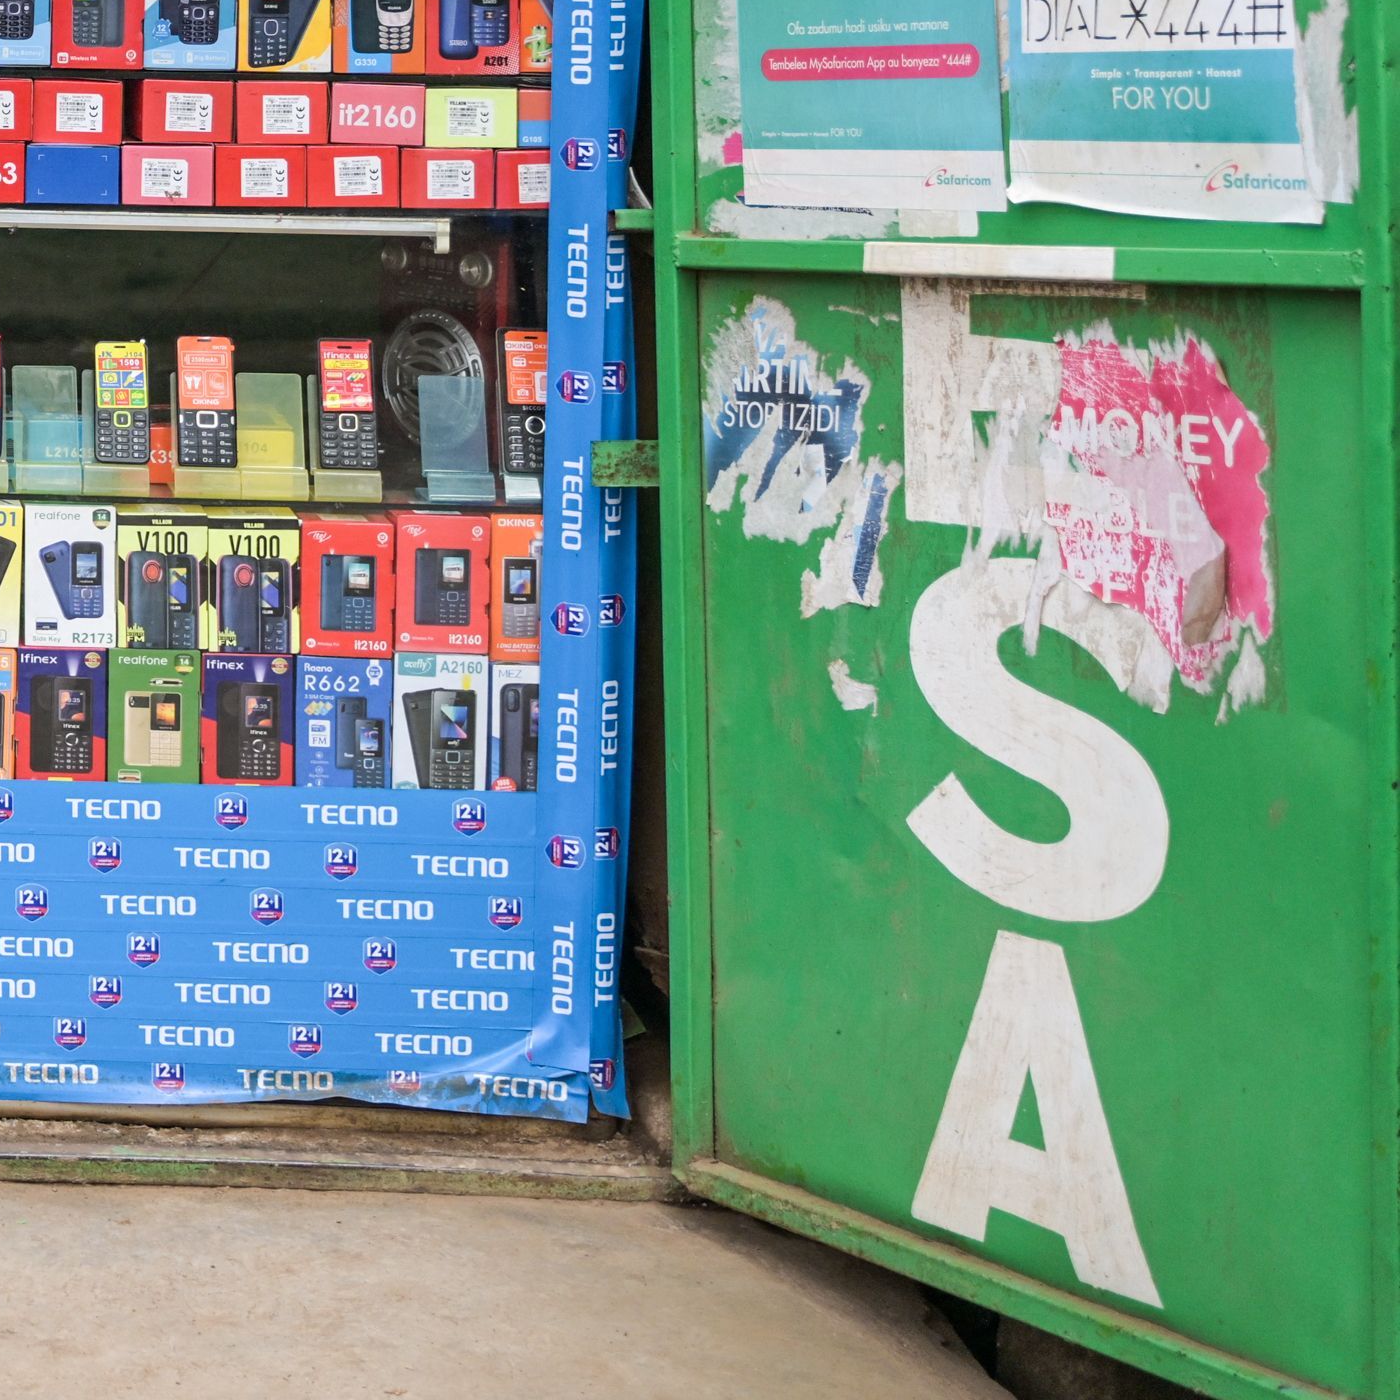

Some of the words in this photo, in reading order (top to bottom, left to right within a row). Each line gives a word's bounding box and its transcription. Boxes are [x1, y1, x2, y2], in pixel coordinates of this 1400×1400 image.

[769, 58, 807, 71] Tembelea
[809, 57, 865, 73] MySafaricom
[867, 57, 886, 72] App
[1090, 68, 1122, 80] Simple
[1134, 68, 1192, 80] Transparent
[1206, 67, 1241, 78] Honest
[1112, 86, 1155, 110] FOR
[1162, 86, 1211, 110] YOU
[339, 103, 416, 129] it2160
[937, 174, 992, 186] Safaricom
[1223, 173, 1307, 191] Safaricom
[562, 456, 583, 551] TECNO
[34, 511, 81, 521] realfone
[497, 518, 535, 527] OKING
[137, 531, 189, 556] V100
[229, 535, 281, 560] V100
[72, 633, 113, 644] R2173
[354, 639, 387, 651] it2160
[117, 654, 168, 666] realfone
[440, 661, 483, 675] A2160
[304, 675, 360, 692] R662
[336, 898, 434, 922] TECNO
[375, 1032, 472, 1056] TECNO
